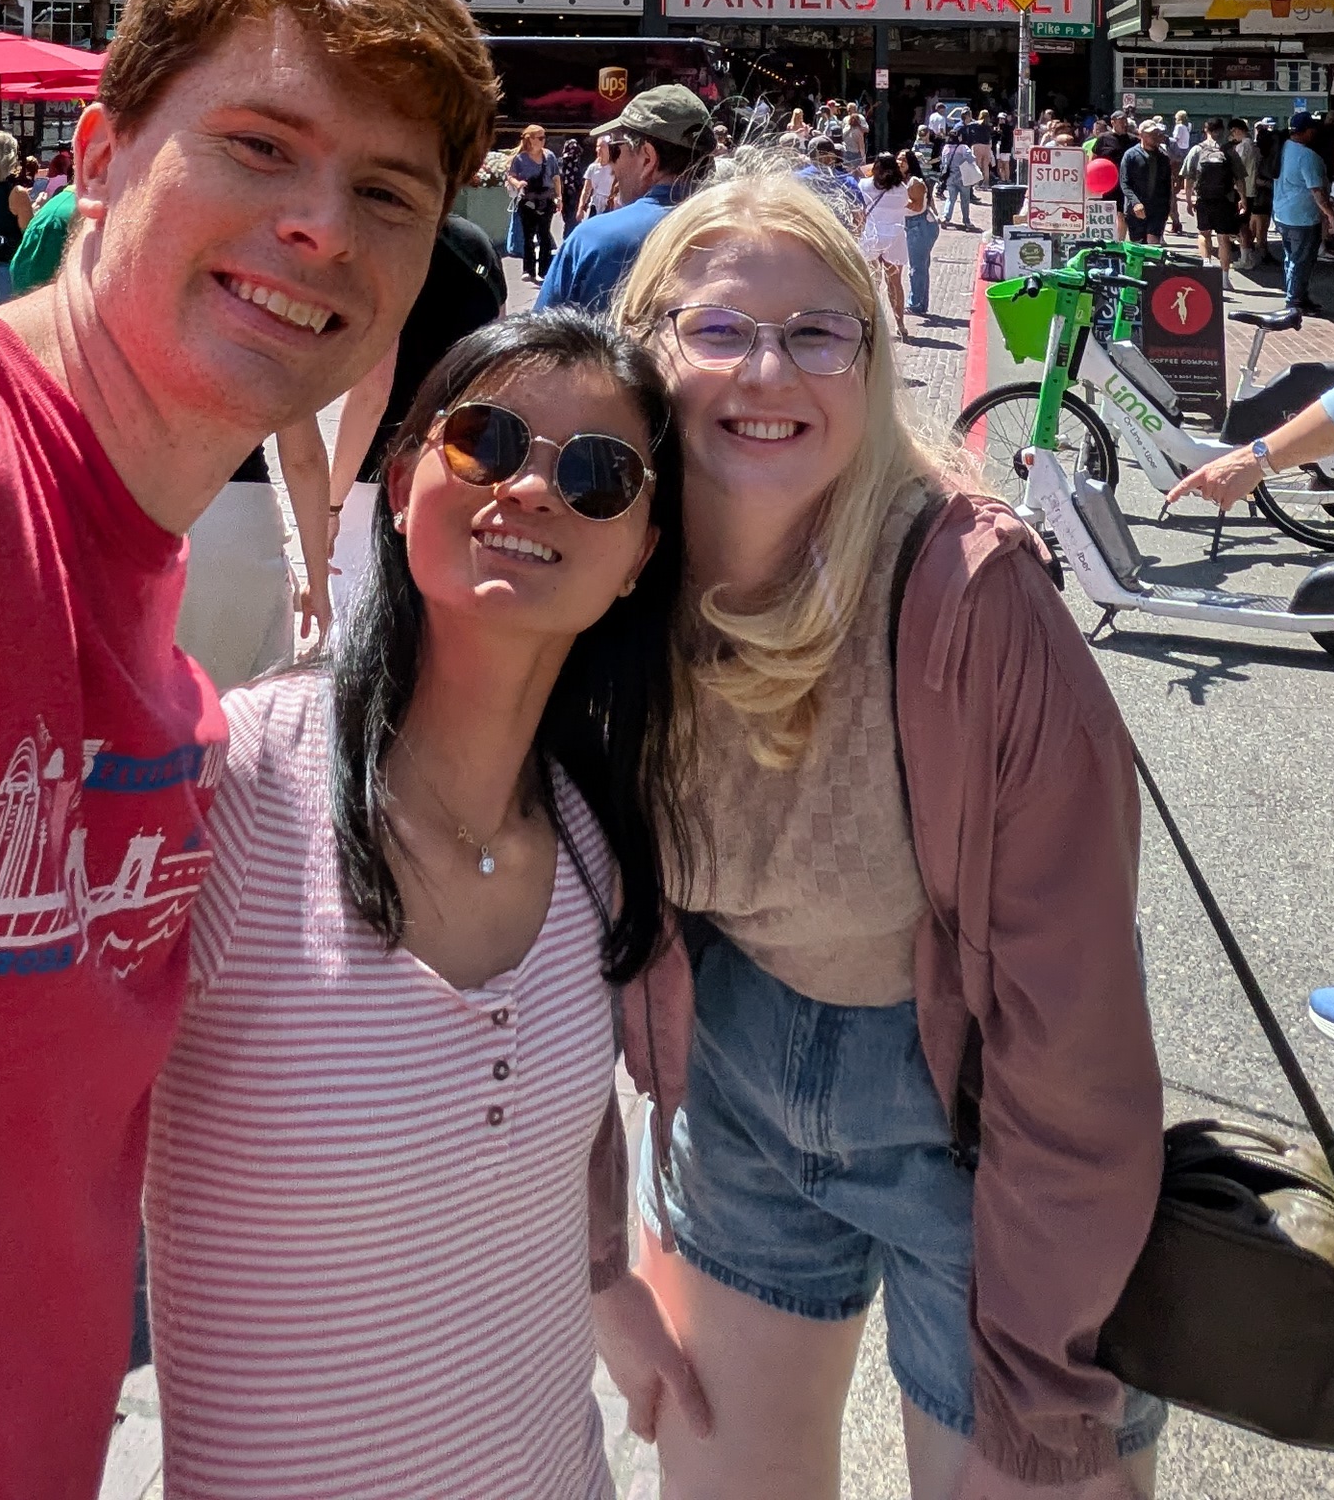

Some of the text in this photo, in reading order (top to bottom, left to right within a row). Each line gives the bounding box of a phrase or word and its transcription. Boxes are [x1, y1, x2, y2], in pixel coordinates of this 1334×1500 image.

[1036, 22, 1061, 35] Pike
[600, 76, 627, 97] ups
[1032, 150, 1049, 163] NO
[1035, 167, 1079, 183] STOPS
[1104, 372, 1164, 434] Lime
